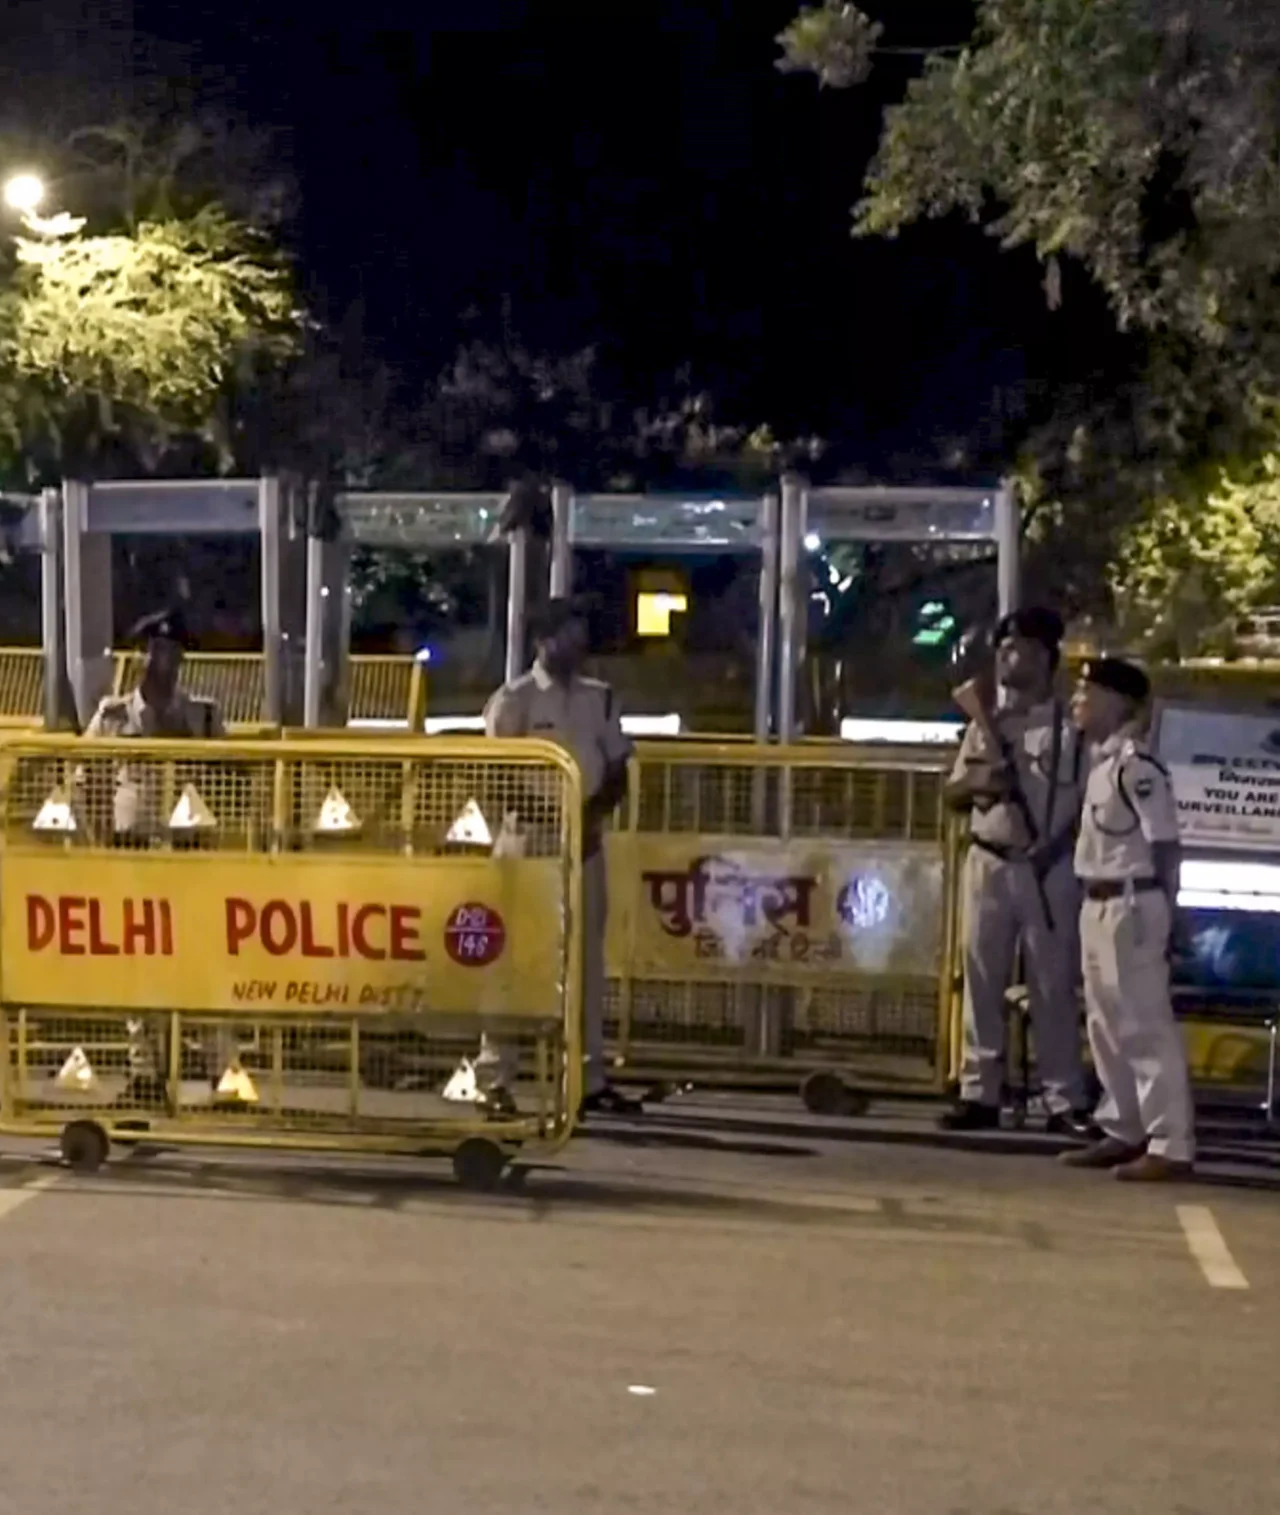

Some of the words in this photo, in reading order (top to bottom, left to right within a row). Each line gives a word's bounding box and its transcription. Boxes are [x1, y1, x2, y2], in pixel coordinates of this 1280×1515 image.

[1205, 787, 1239, 801] YOU
[1245, 792, 1279, 804] ARE
[1177, 800, 1280, 818] URVEILLAN
[25, 895, 174, 955] DELHI
[225, 897, 427, 961] POLICE
[232, 979, 277, 1003] NEW
[285, 980, 349, 1005] DELHI
